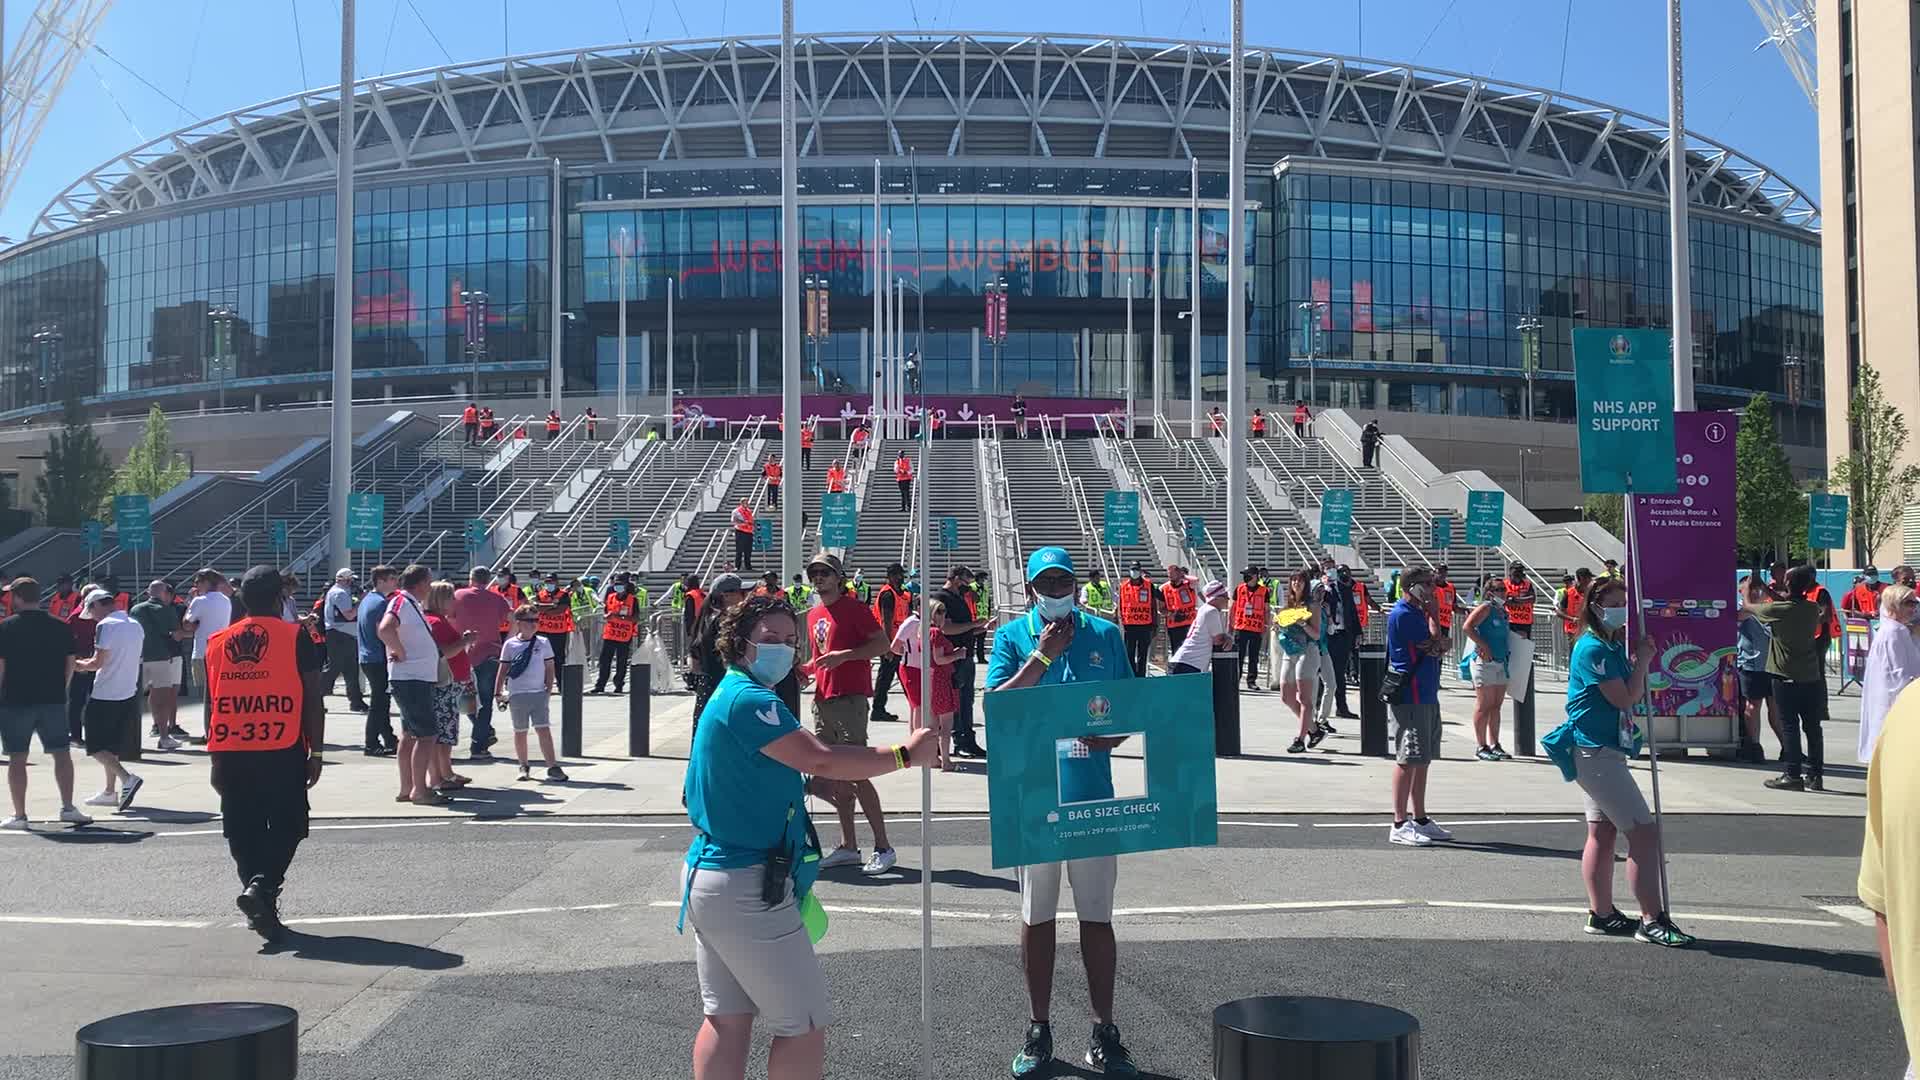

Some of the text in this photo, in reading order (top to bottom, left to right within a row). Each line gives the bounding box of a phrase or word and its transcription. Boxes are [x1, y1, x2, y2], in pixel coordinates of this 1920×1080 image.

[1593, 401, 1657, 414] NHS APP
[1592, 418, 1660, 431] SUPPORT
[215, 694, 294, 714] EWARD
[1068, 802, 1161, 821] BAG SIZE CHECK
